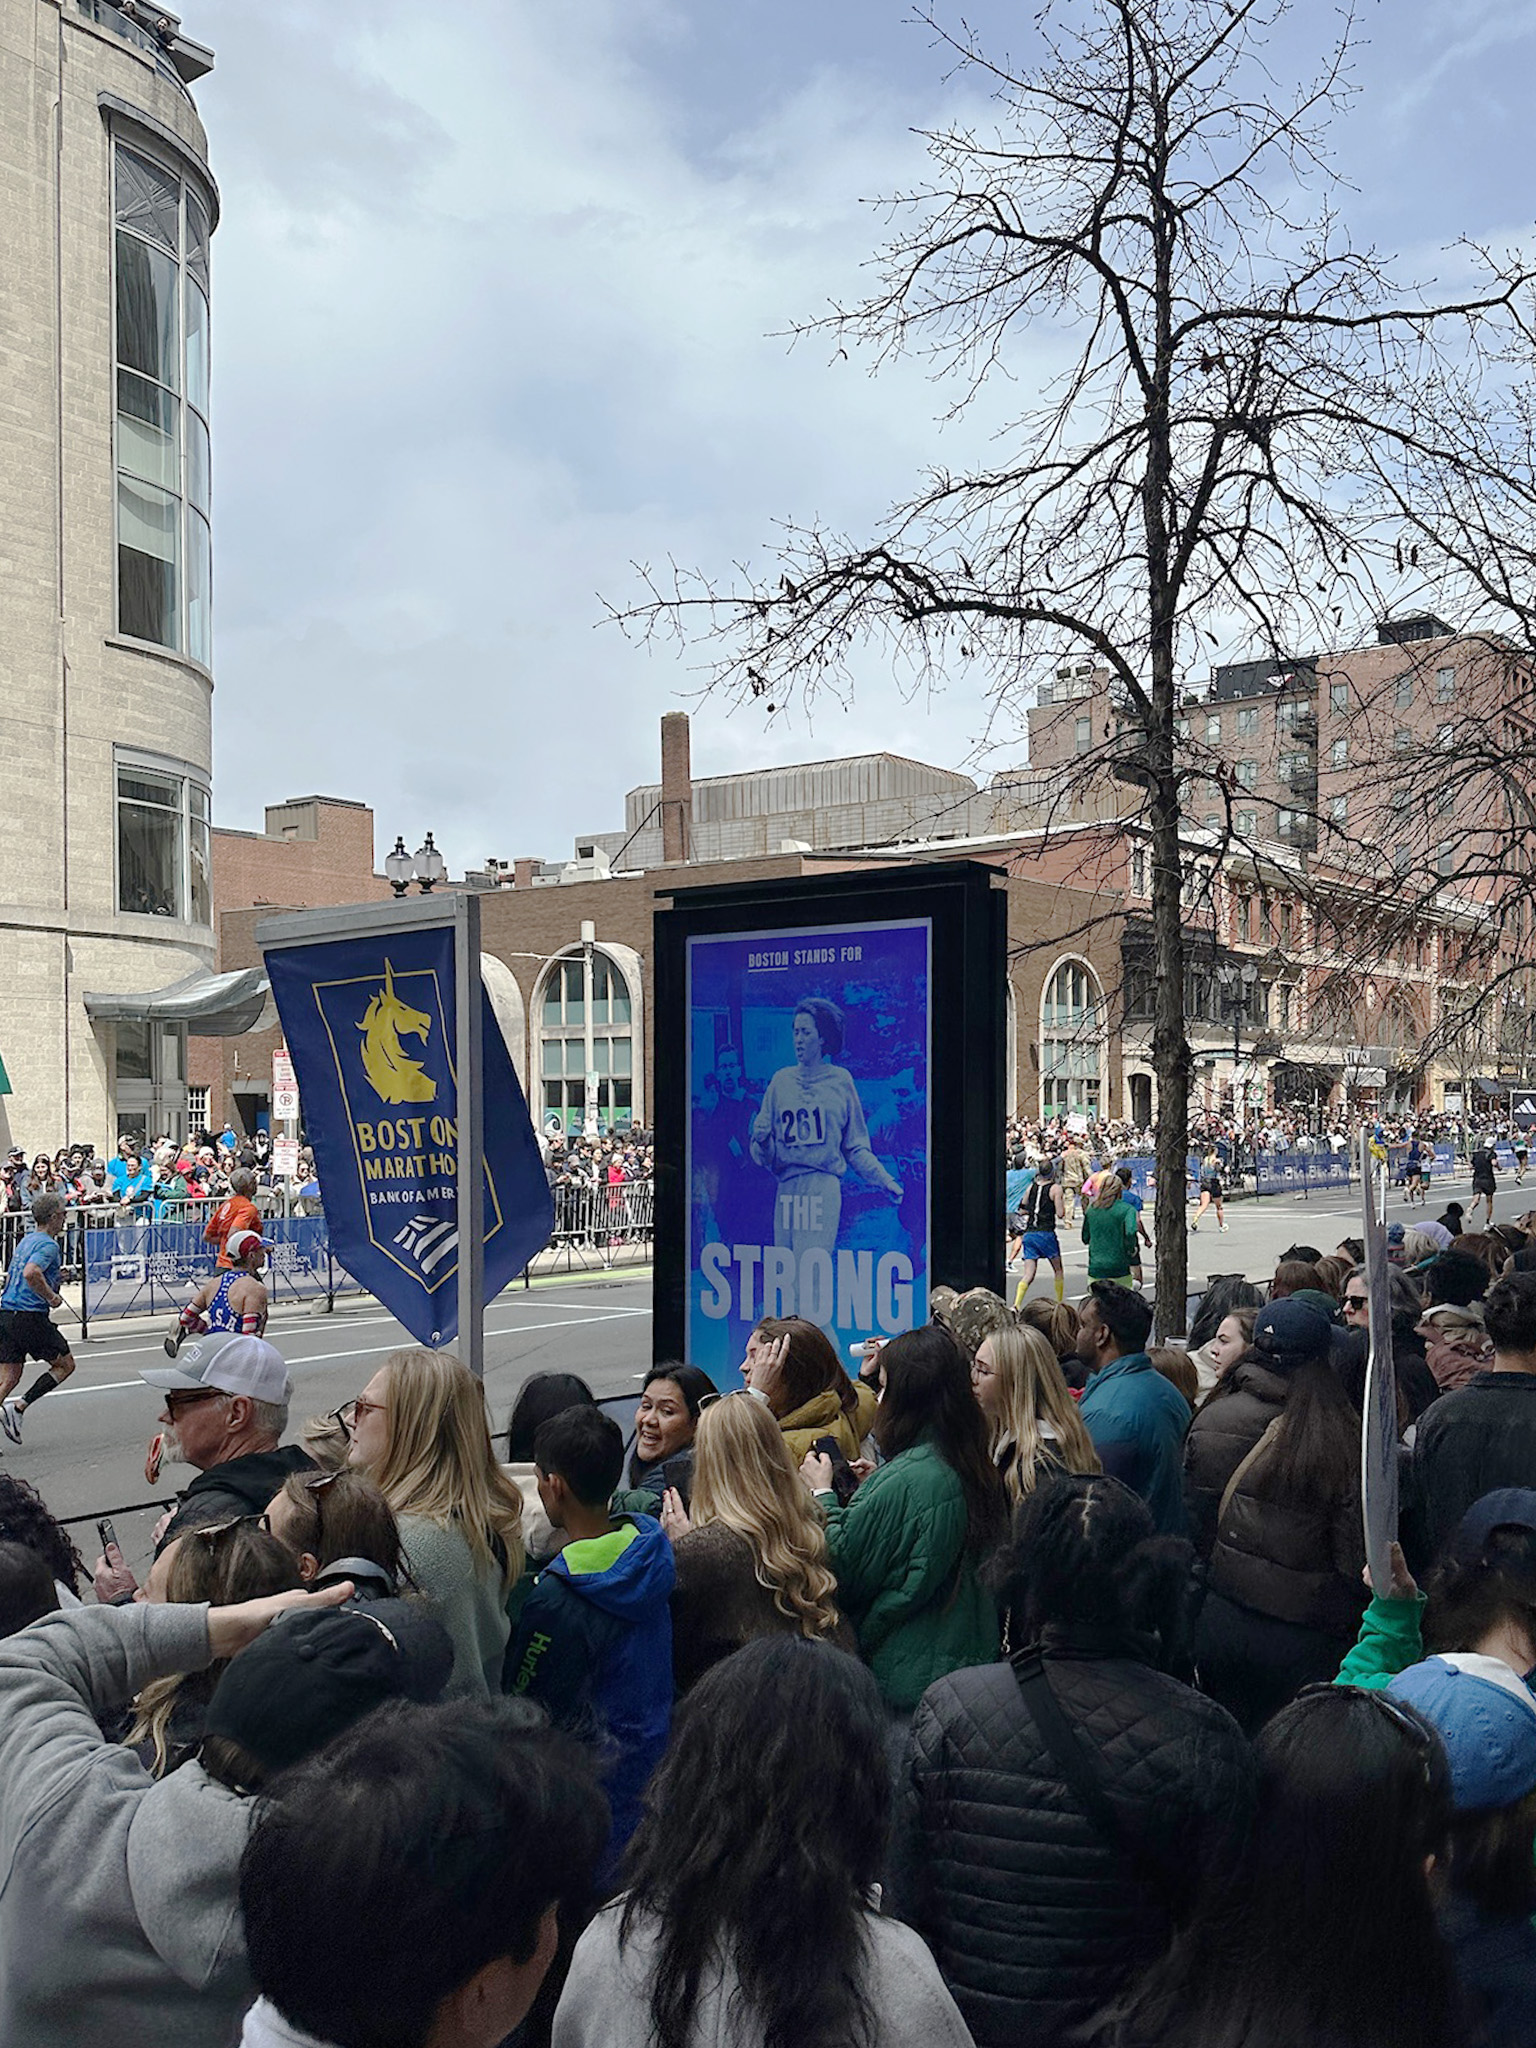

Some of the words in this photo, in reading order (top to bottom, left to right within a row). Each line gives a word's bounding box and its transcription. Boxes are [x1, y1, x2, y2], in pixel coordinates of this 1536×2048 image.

[748, 951, 789, 968] BOSTON
[793, 947, 836, 965] STANDS
[840, 946, 862, 962] FOR
[781, 1106, 823, 1144] 261
[363, 1152, 458, 1181] MARATHO
[370, 1190, 400, 1205] BANK
[401, 1190, 414, 1203] OF
[415, 1186, 458, 1202] AMER
[780, 1194, 824, 1231] THE
[700, 1242, 914, 1335] STRONG
